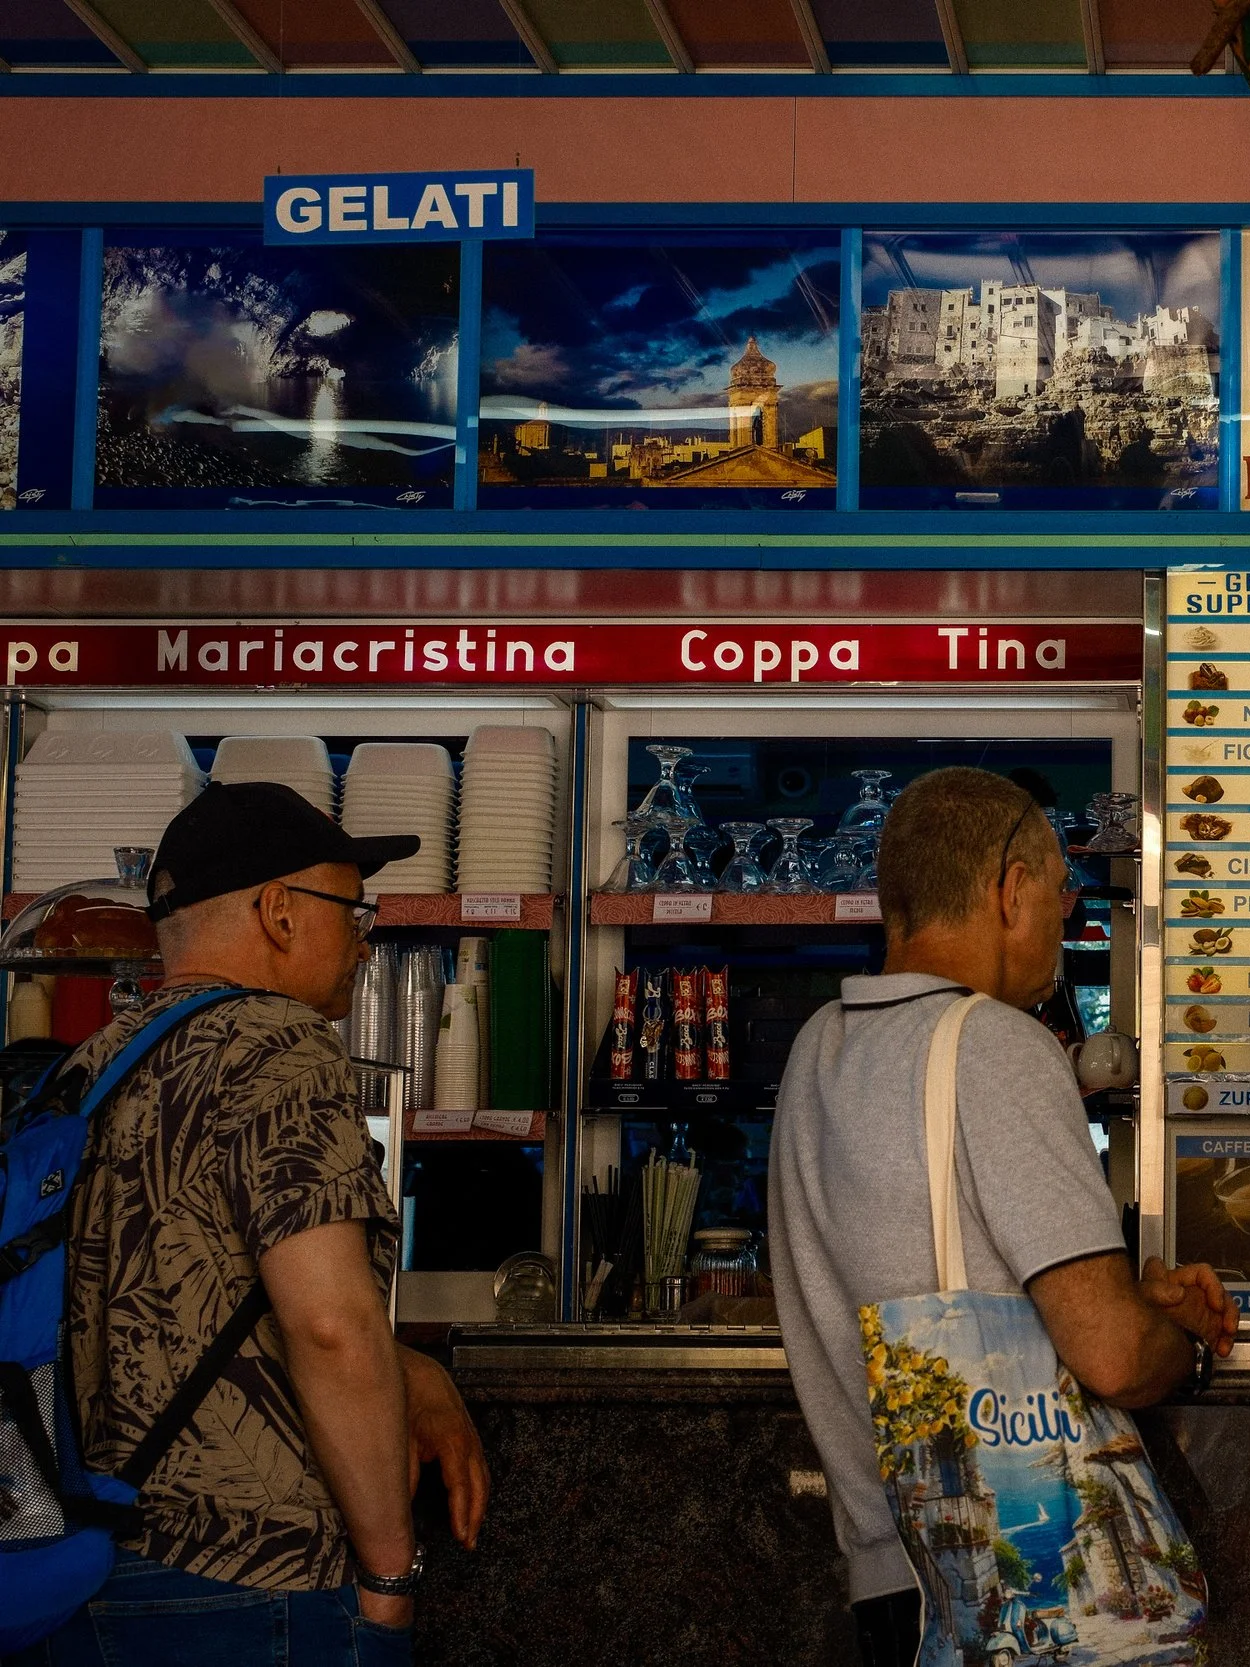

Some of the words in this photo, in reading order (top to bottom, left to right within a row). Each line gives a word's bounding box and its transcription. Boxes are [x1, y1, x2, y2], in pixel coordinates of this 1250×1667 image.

[276, 182, 518, 234] GELATI
[8, 641, 79, 686] pa
[157, 629, 576, 672] Mariacristina
[681, 629, 860, 682] Coppa
[938, 627, 1067, 670] Tina
